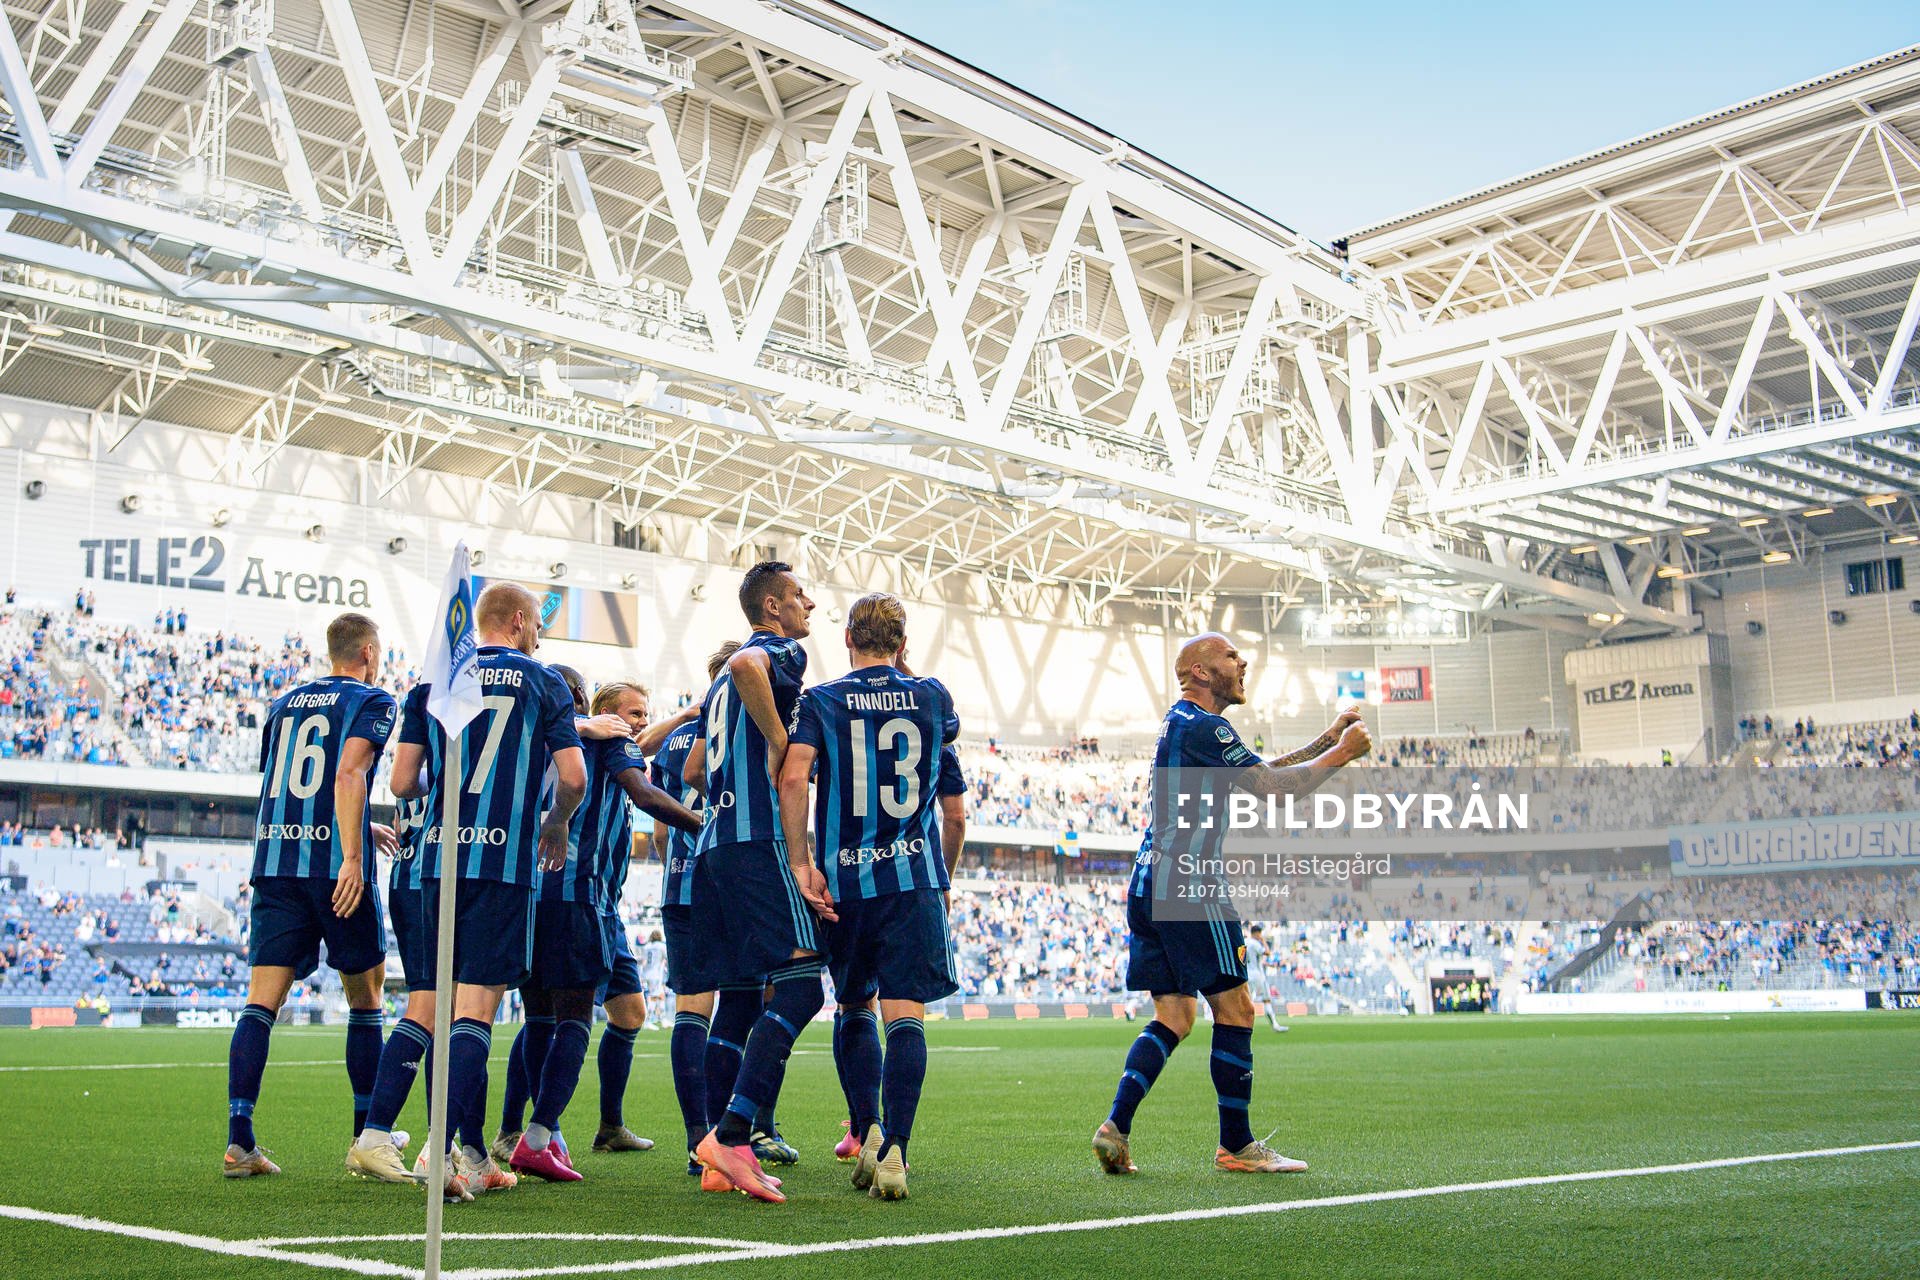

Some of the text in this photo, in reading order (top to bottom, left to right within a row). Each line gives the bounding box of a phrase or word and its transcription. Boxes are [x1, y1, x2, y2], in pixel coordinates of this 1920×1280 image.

[80, 535, 372, 609] TELE2 Arena
[287, 692, 341, 709] LÖFGREN
[846, 691, 919, 711] FINNDELL
[1583, 680, 1694, 705] TELE2 Arena
[706, 682, 730, 772] 9
[270, 714, 331, 799] 16
[850, 718, 922, 819] 13
[267, 824, 330, 841] FXORO
